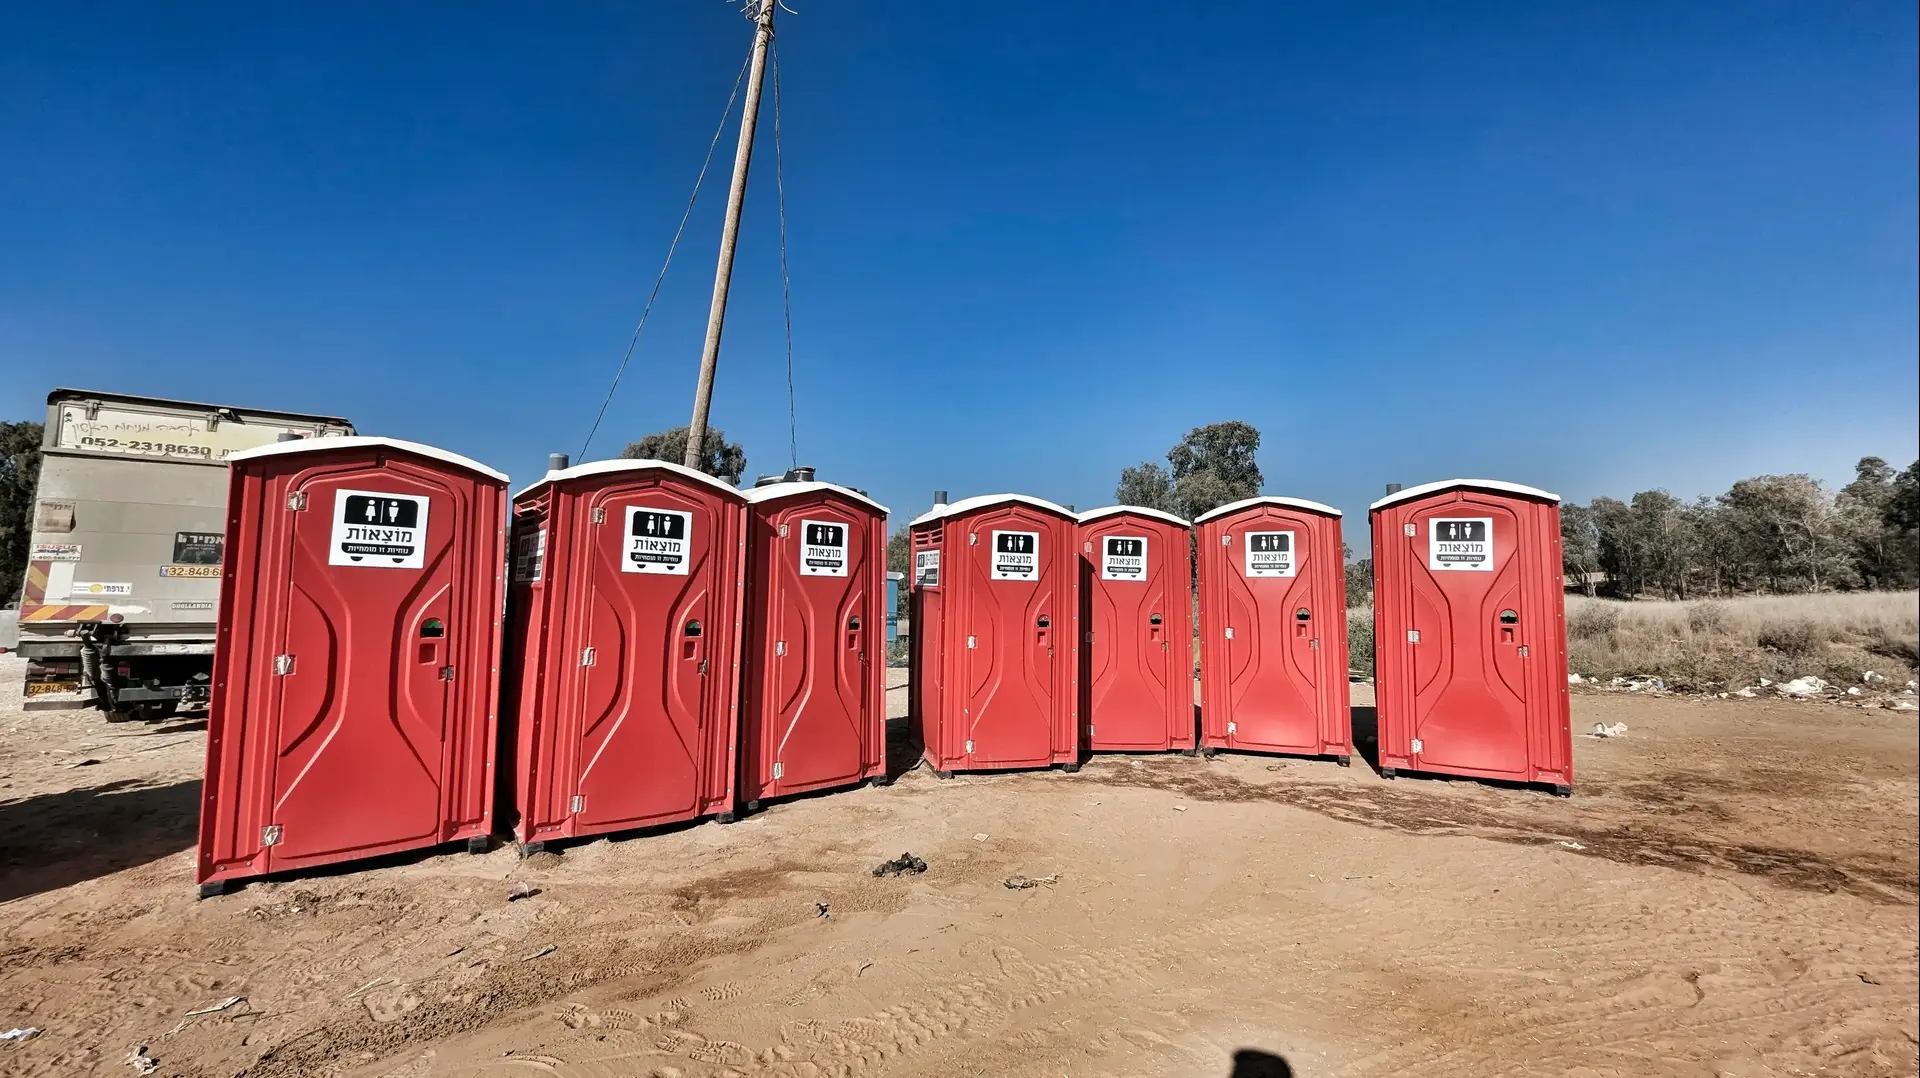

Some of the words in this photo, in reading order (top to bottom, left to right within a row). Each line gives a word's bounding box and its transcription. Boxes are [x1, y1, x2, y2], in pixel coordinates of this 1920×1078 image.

[81, 436, 211, 457] 052-2318630
[347, 545, 377, 553] מומחיות
[387, 546, 409, 555] נוחיות
